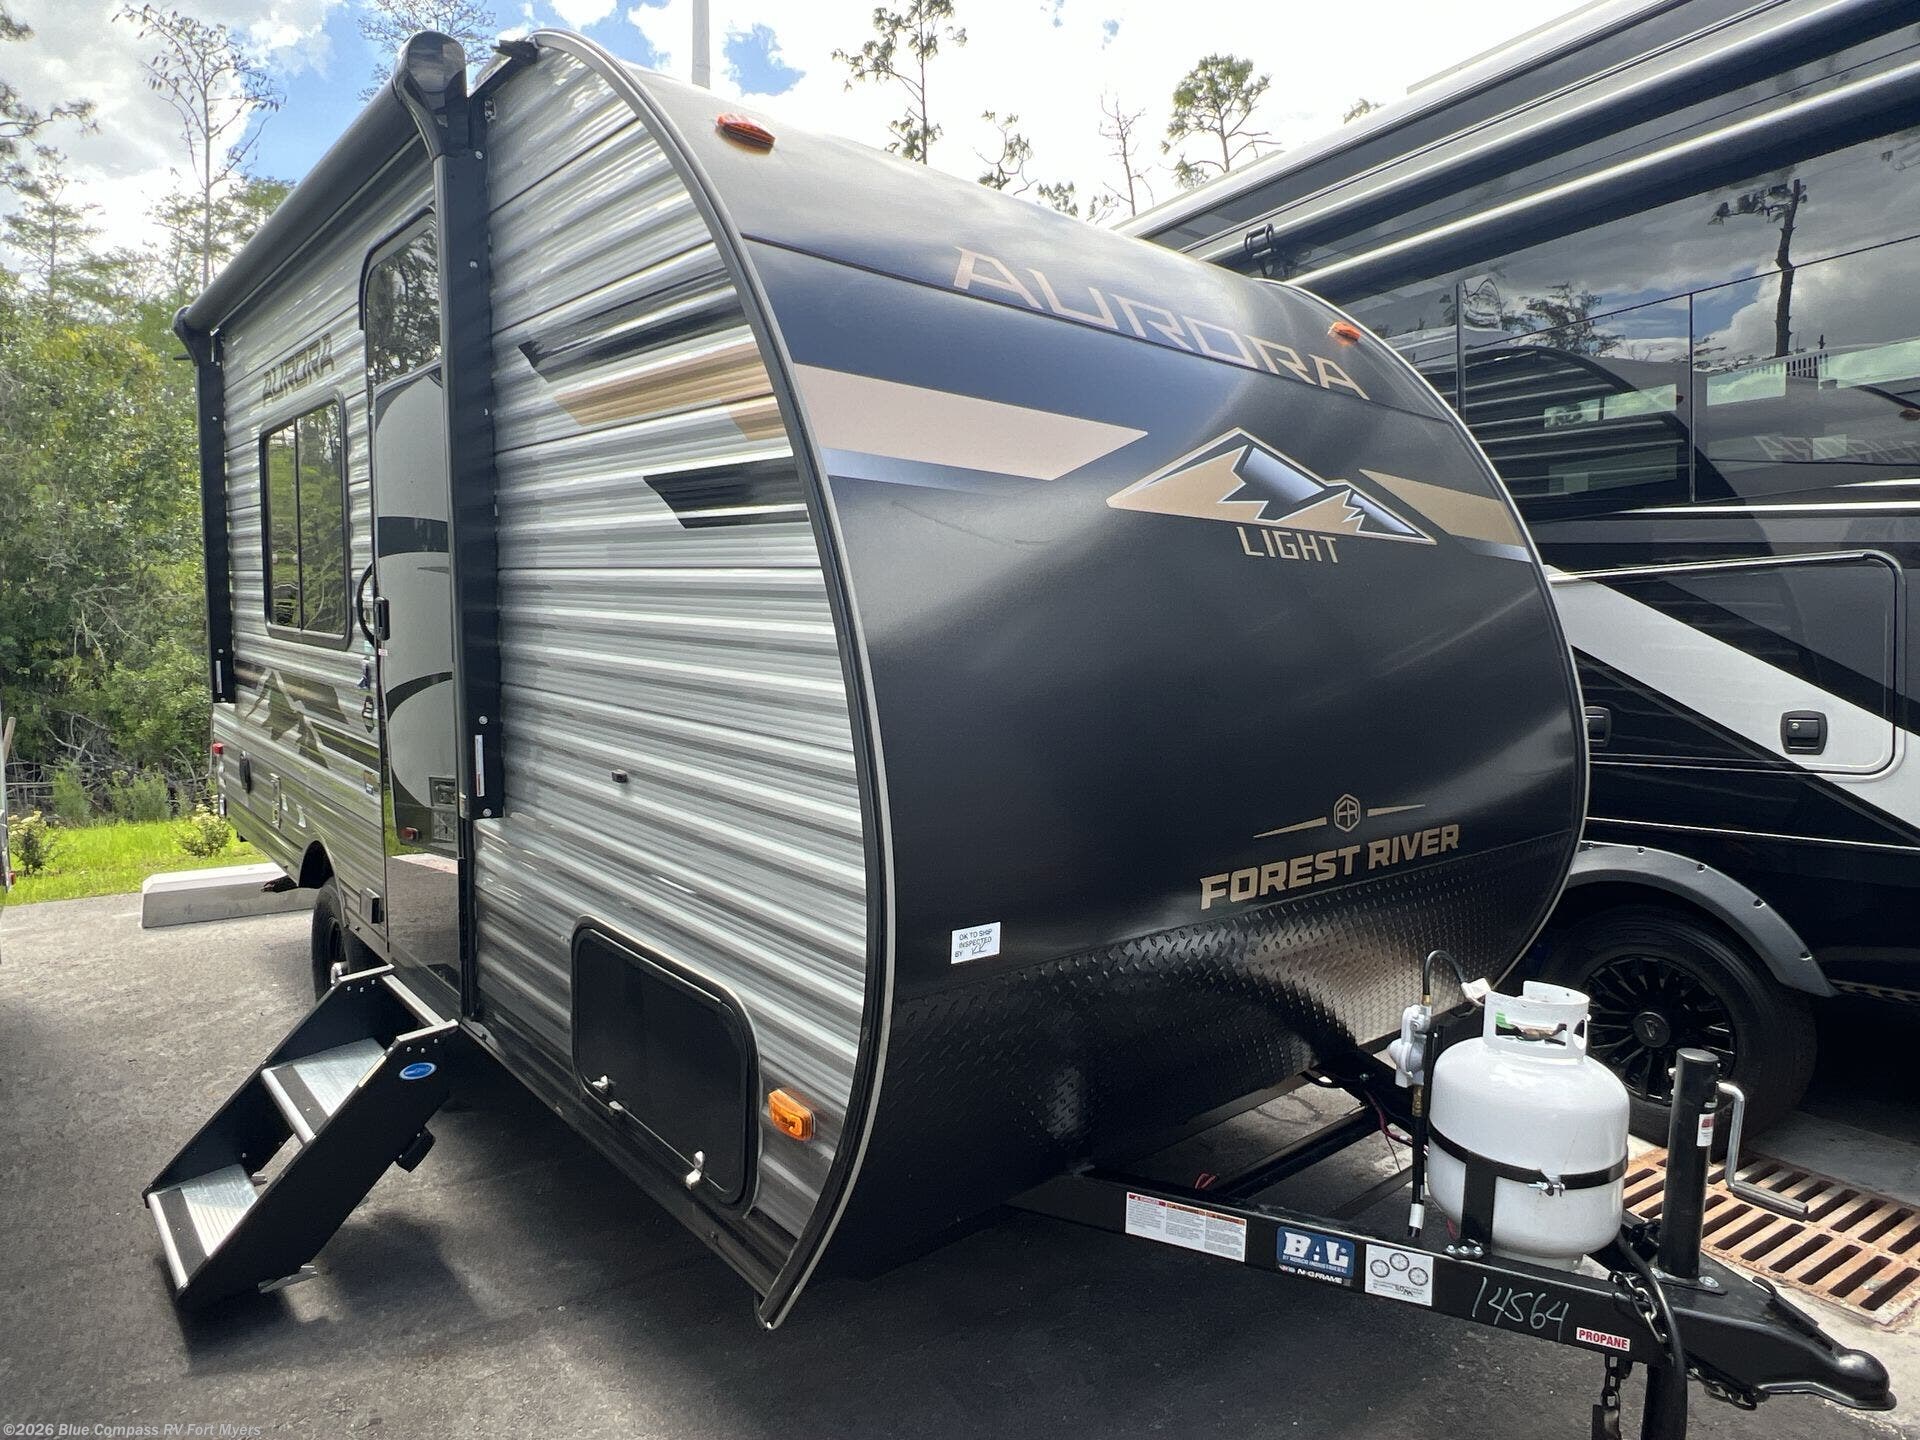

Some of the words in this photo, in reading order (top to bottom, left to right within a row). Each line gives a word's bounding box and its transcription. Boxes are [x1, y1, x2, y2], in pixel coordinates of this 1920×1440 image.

[953, 247, 1371, 401] AURORA
[262, 332, 334, 407] AURORA
[1236, 527, 1339, 564] LIGHT
[1200, 845, 1361, 911] FOREST
[1367, 824, 1460, 870] RIVER
[959, 933, 968, 941] OK
[979, 928, 992, 937] SHIP
[959, 936, 992, 949] INSPECTED
[954, 950, 963, 958] BY
[1283, 1231, 1349, 1268] BAL
[1471, 1276, 1570, 1343] 14564
[1578, 1329, 1629, 1350] PROPANE
